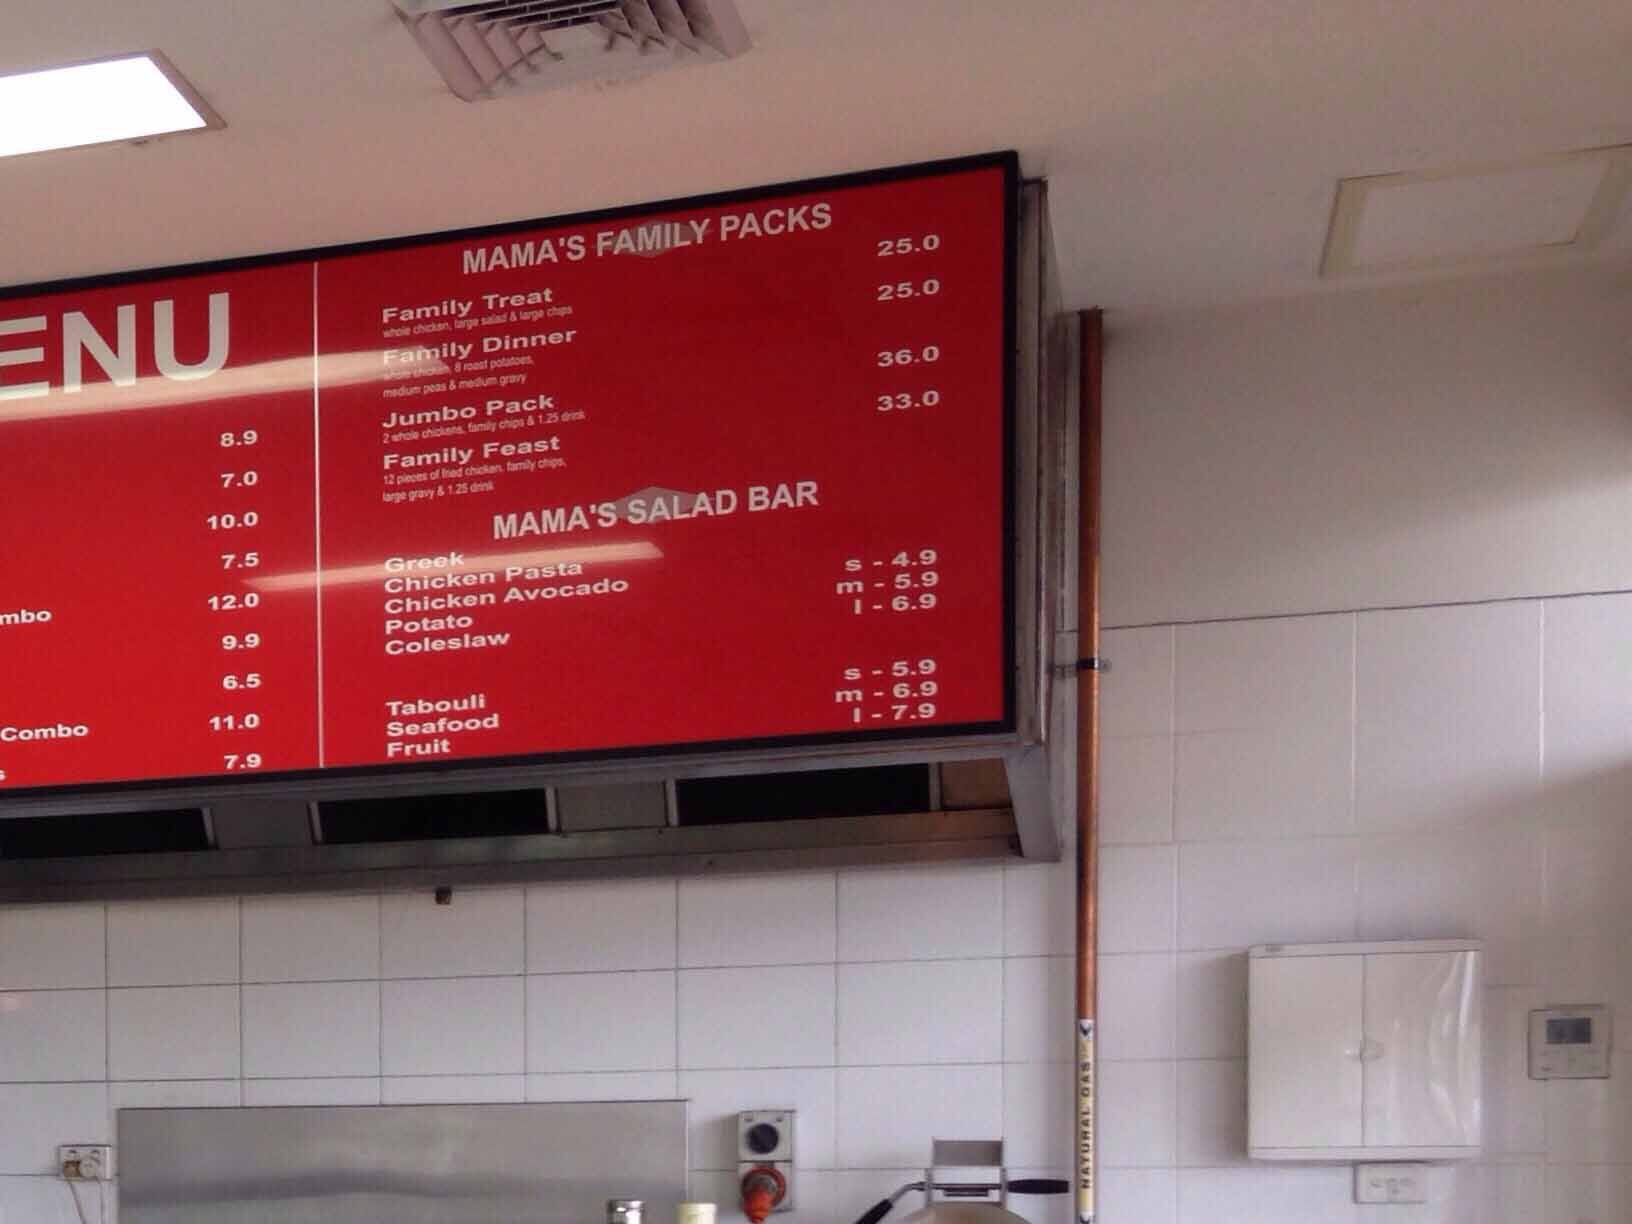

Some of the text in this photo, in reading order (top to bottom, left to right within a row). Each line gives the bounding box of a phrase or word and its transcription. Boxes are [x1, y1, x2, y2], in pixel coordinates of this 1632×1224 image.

[463, 203, 832, 274] MAMA'S FAMILY PACKS
[877, 234, 940, 257] 25.0
[877, 279, 940, 301] 25.0
[382, 288, 552, 323] Family Treat
[382, 330, 576, 366] Family Dinner
[878, 346, 939, 367] 36.0
[877, 390, 939, 411] 33.0
[382, 394, 554, 428] Jumbo Pack
[220, 430, 258, 447] 8.9
[384, 436, 560, 469] Family Feast
[221, 471, 258, 488] 7.0
[493, 481, 818, 540] MAMA'S SALAD BAR
[207, 512, 258, 530] 10.0
[221, 552, 259, 569] 7.5
[384, 552, 465, 574] Greek
[891, 549, 937, 567] 4.9
[384, 561, 584, 594] Chicken Pasta
[895, 571, 939, 589] 5.9
[208, 592, 259, 610] 12.0
[384, 578, 629, 614] Chicken Avocado
[892, 593, 936, 611] 6.9
[385, 615, 473, 635] Potato
[222, 633, 260, 650] 9.9
[385, 633, 510, 655] Coleslaw
[892, 659, 936, 677] 5.9
[223, 673, 261, 690] 6.5
[893, 681, 938, 698] 6.9
[385, 694, 485, 716] Tabouli
[891, 702, 936, 720] 7.9
[209, 713, 259, 730] 11.0
[387, 713, 499, 737] Seafood
[0, 723, 88, 742] Combo
[387, 739, 450, 757] Fruit
[224, 753, 262, 769] 7.9
